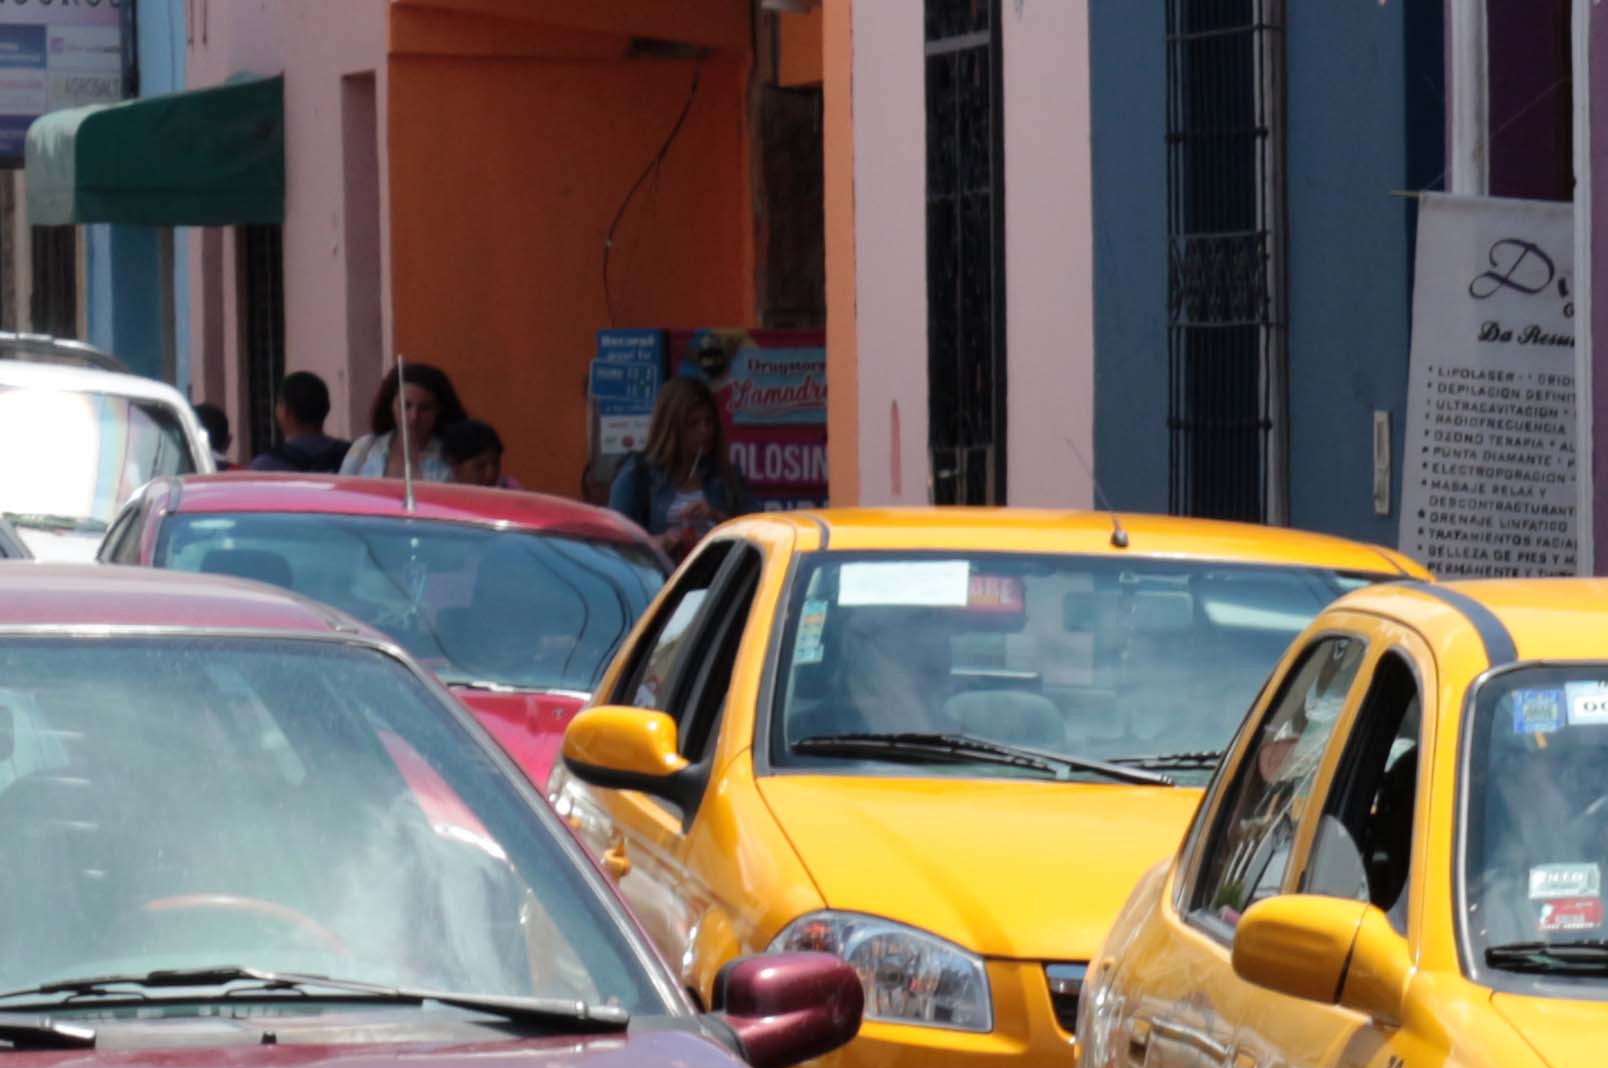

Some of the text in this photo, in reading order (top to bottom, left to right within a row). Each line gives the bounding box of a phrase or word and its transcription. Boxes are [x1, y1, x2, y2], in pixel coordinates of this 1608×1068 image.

[1438, 366, 1515, 382] LIPOLASER
[1435, 413, 1566, 434] RADIOFRECUENCIA
[1434, 429, 1484, 446] OZONO
[1489, 436, 1544, 450] TERAPIA
[1432, 446, 1477, 460] PUNTA
[1483, 449, 1551, 467] DIAMANTE
[1432, 463, 1566, 484] ELECTROPORACION
[1431, 479, 1547, 499] MASAJE RELAX Y
[1430, 511, 1568, 534] DRENAJE LINFATICO
[1428, 527, 1531, 547] TRATAMIENTOS
[1428, 544, 1488, 560] BELLEZA
[1494, 549, 1511, 563] DE
[1518, 551, 1547, 565] PIES
